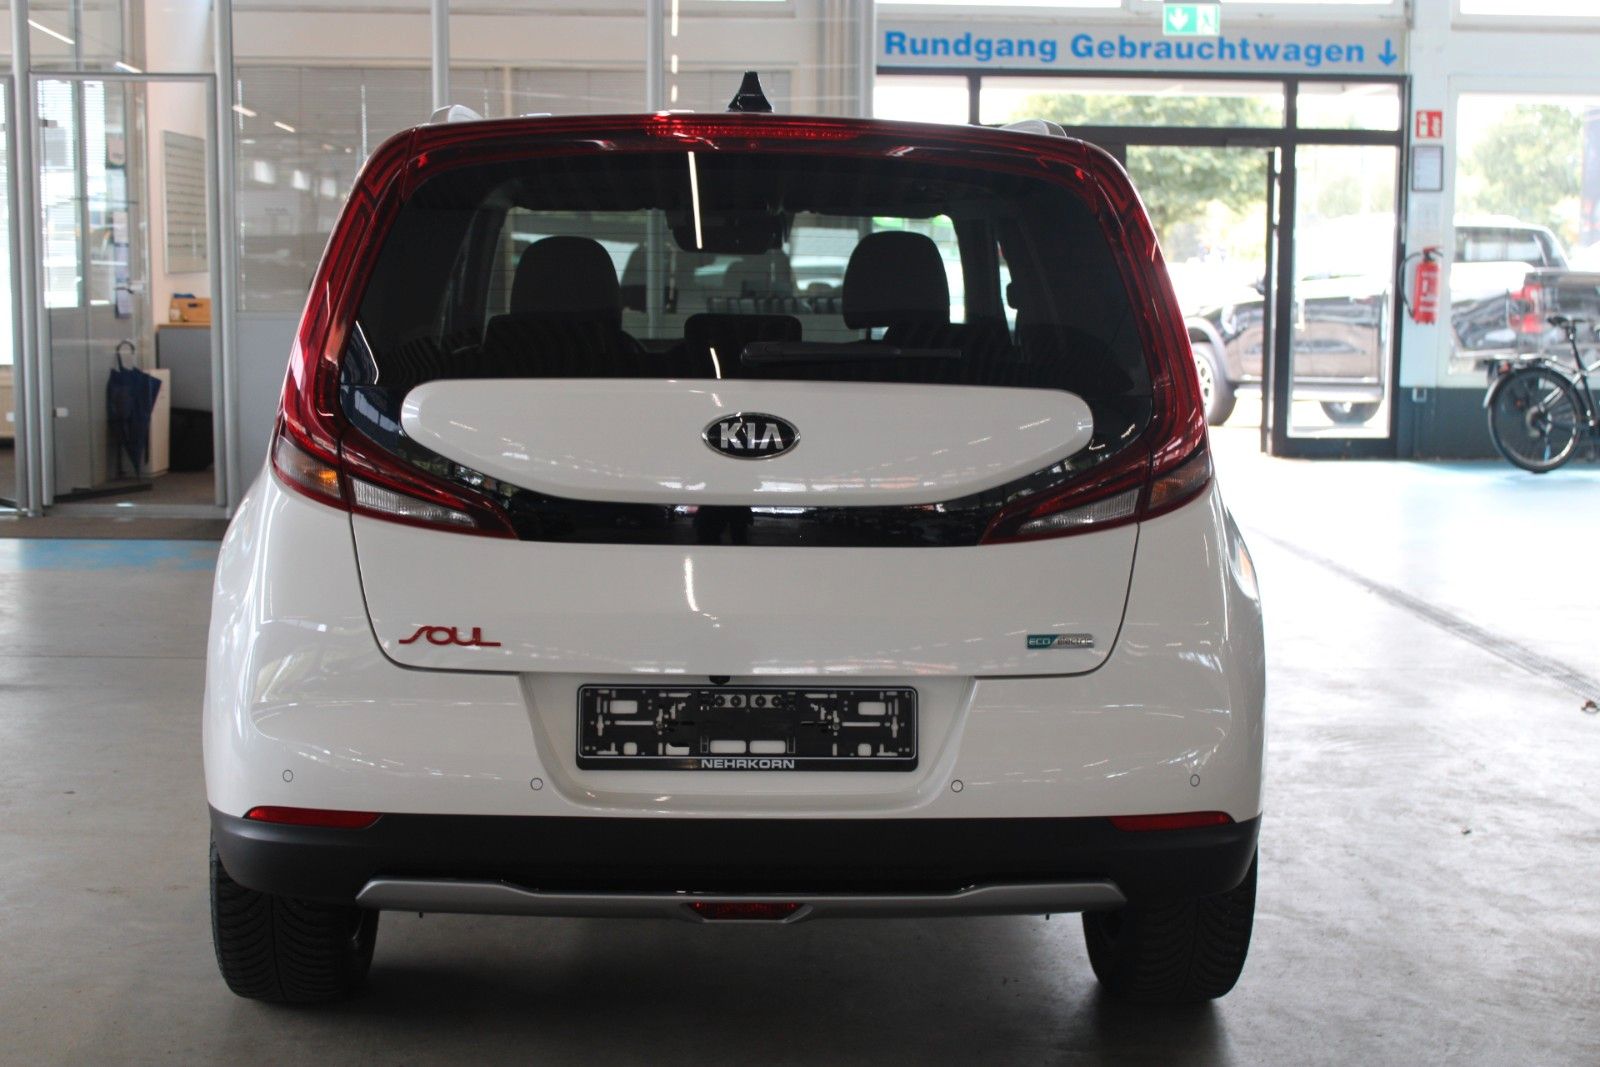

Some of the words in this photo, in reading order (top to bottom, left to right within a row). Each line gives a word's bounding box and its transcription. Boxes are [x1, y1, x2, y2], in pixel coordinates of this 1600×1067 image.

[884, 30, 1058, 63] Rundgang
[1070, 33, 1366, 67] Gebrauchtwagen
[719, 422, 785, 450] KIA
[701, 758, 796, 769] NEHRKORN
